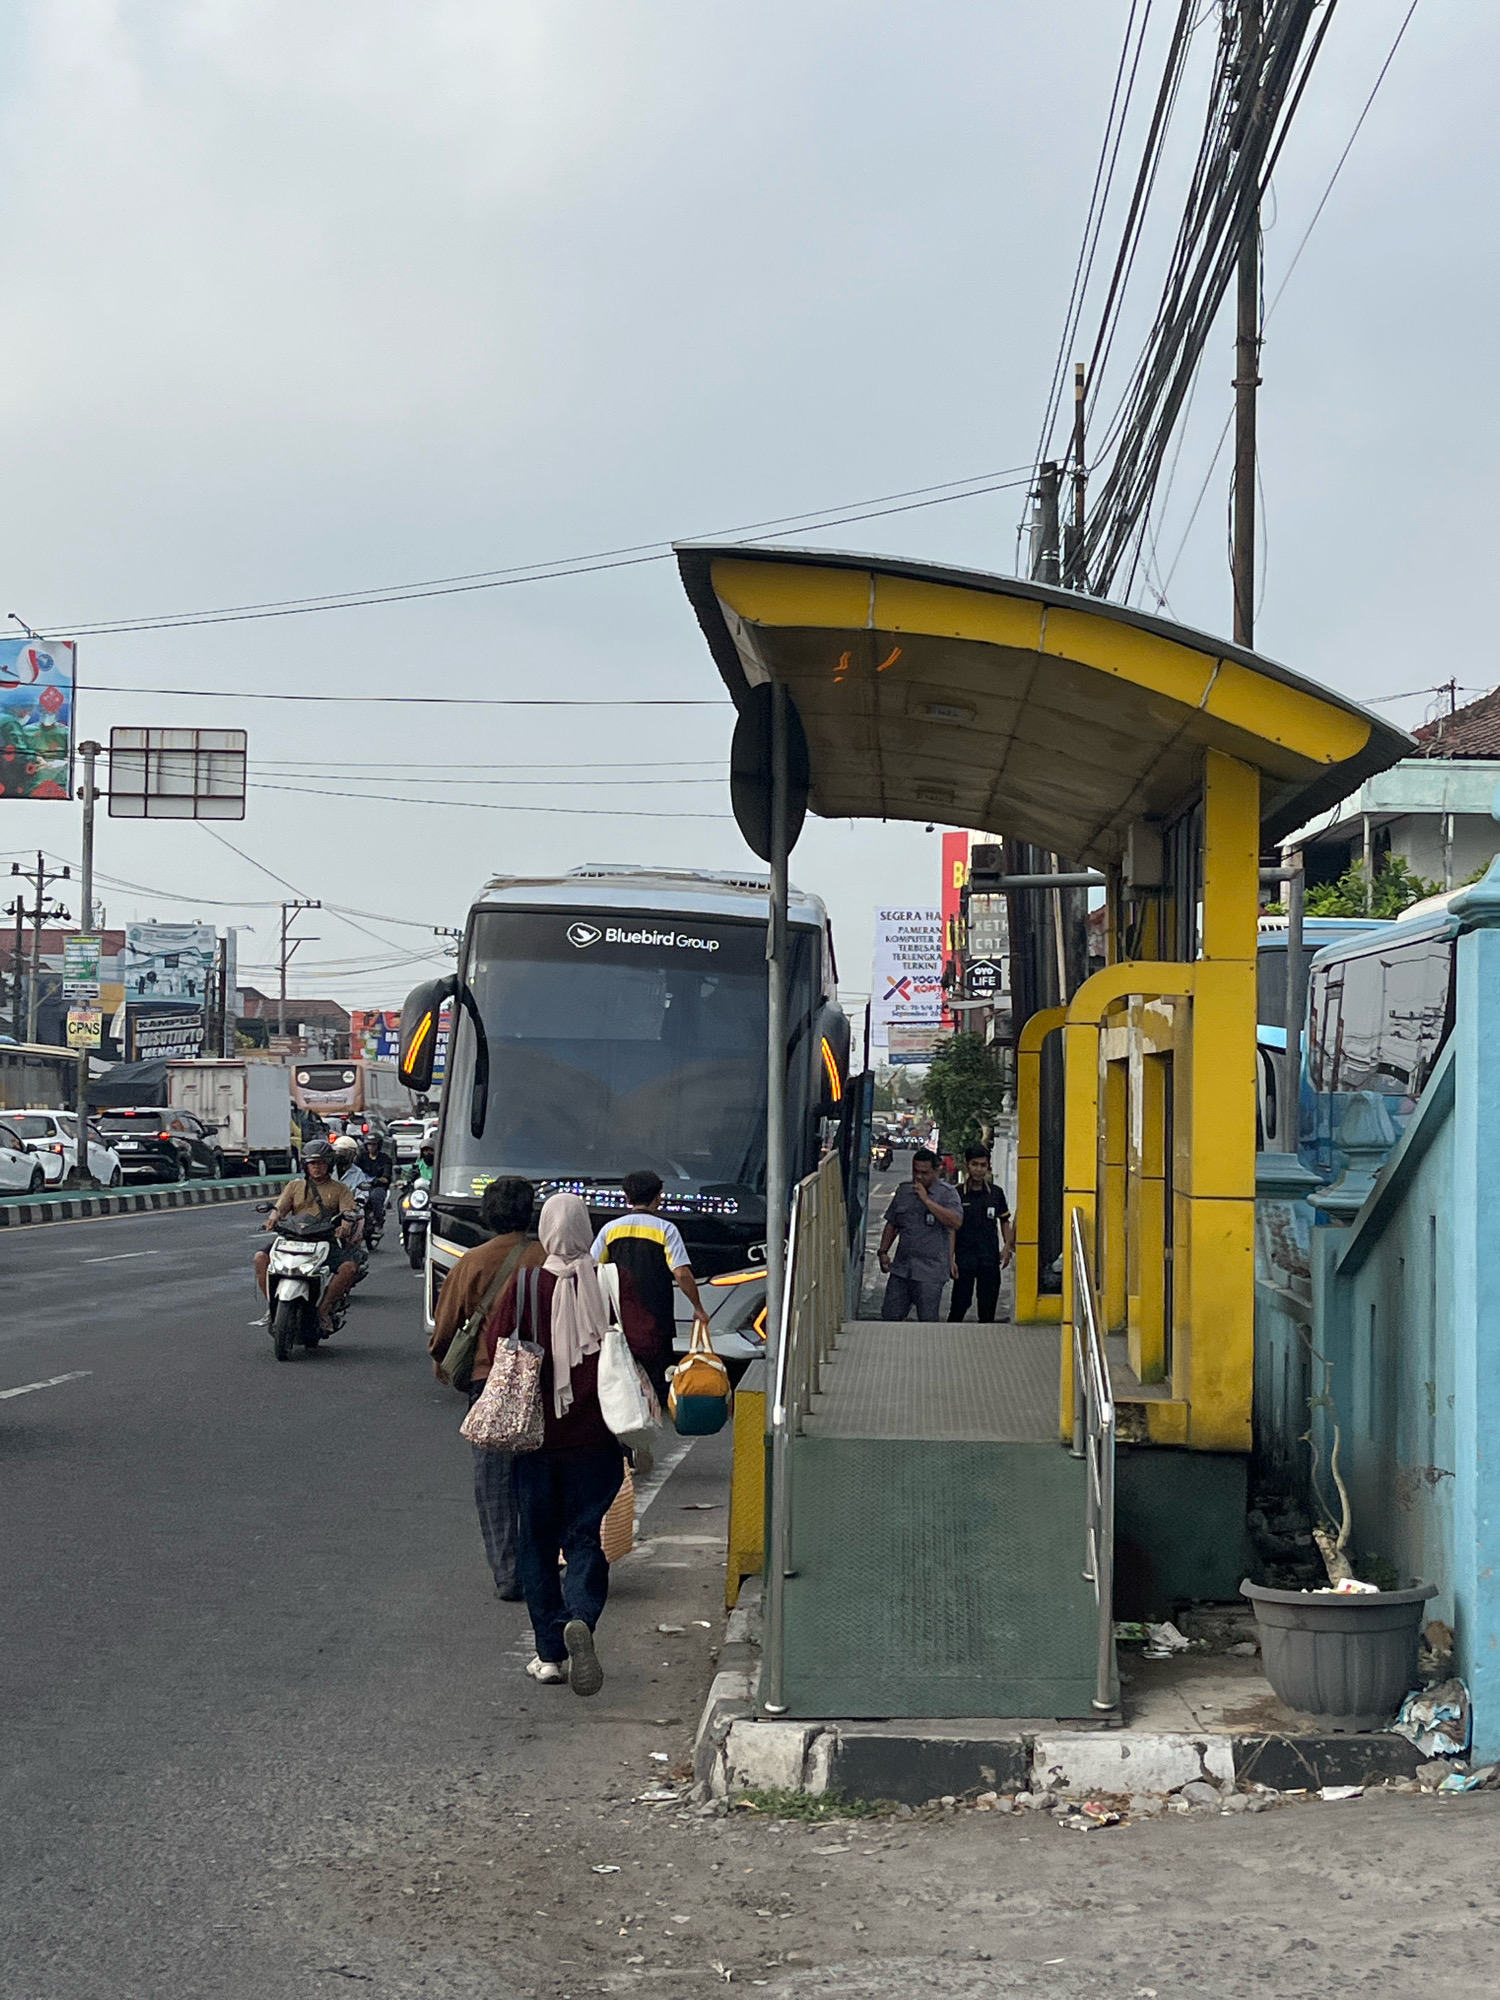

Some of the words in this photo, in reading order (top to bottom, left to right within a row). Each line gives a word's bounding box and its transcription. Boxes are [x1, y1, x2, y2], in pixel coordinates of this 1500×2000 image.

[972, 901, 1007, 914] BENG
[879, 911, 922, 921] SEGERA
[925, 911, 942, 921] HA
[898, 926, 943, 934] PAMERAN
[974, 919, 1009, 932] KETH
[605, 928, 675, 946] Bluebird
[676, 934, 721, 953] Group
[885, 935, 934, 943] KOMPUTER
[975, 938, 1002, 950] CAT
[898, 944, 942, 952] TERBESAR
[892, 953, 943, 961] TERLENGKA
[903, 962, 938, 970] TERKINI
[974, 967, 994, 976] OYO
[911, 975, 942, 984] YOGY
[972, 976, 997, 987] LIFE
[138, 1016, 200, 1028] KAMPUS
[68, 1021, 101, 1035] CPNS
